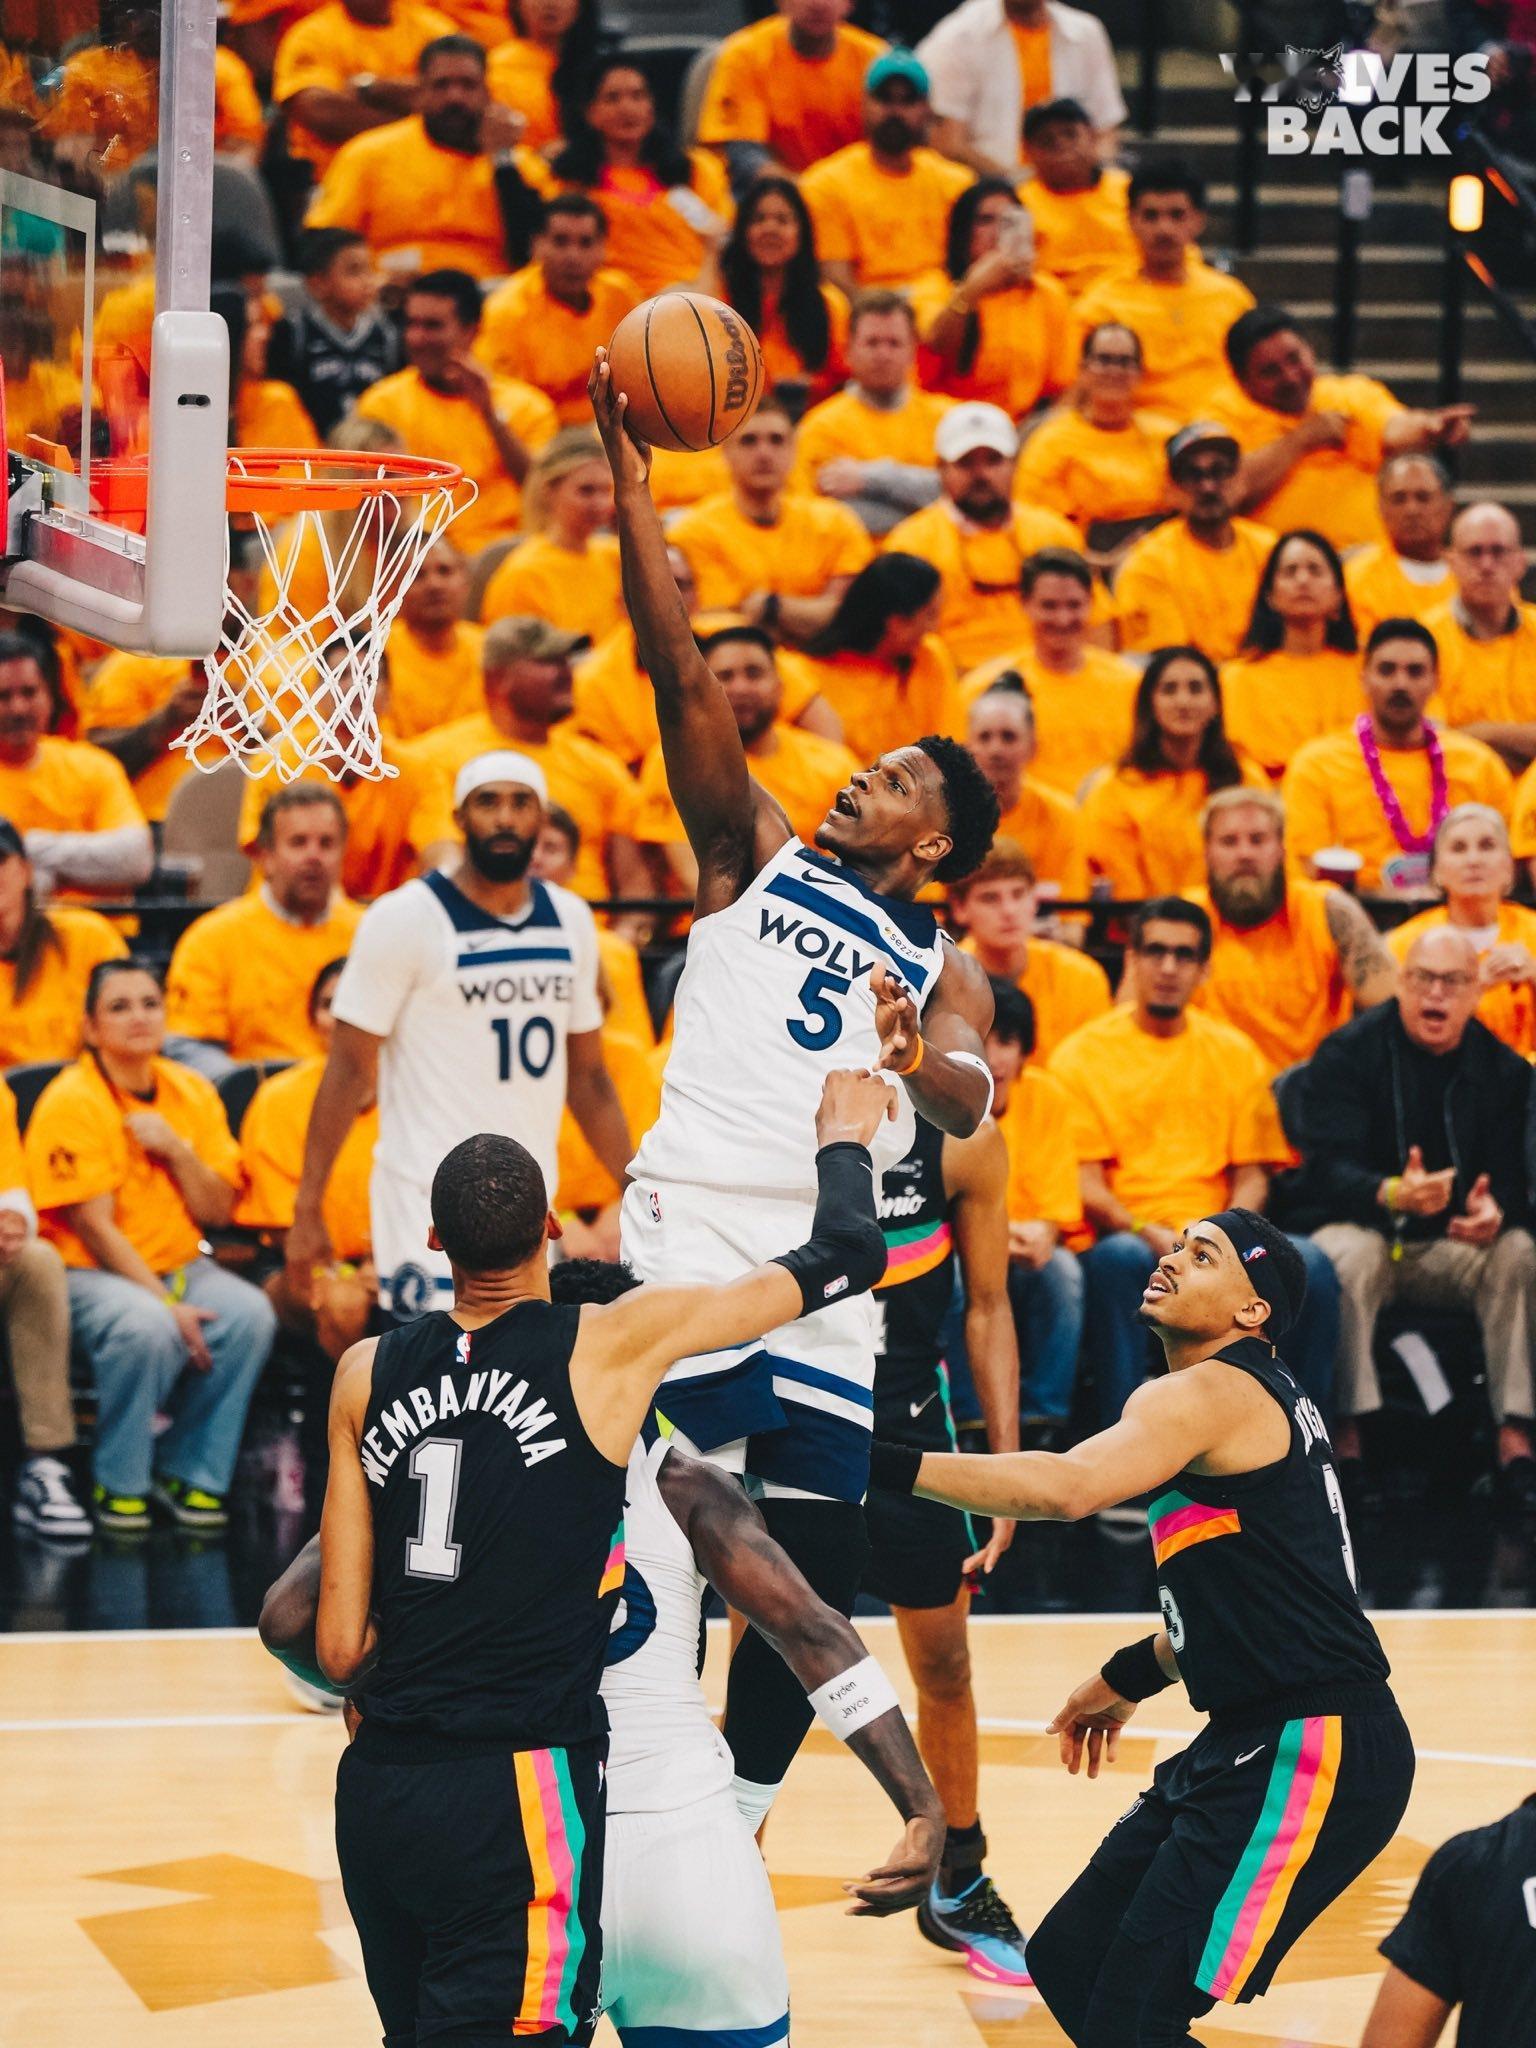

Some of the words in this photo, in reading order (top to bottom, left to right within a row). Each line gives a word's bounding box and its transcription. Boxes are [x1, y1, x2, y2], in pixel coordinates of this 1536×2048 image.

[760, 908, 910, 992] WOLV
[890, 933, 923, 960] sezzle
[459, 976, 573, 1003] WOLVE
[786, 967, 852, 1051] 5
[491, 1016, 555, 1081] 10
[361, 1369, 567, 1487] WEMBANYAMA
[405, 1437, 463, 1582] 1
[828, 1680, 857, 1703] Kyden
[841, 1696, 870, 1719] Jayce
